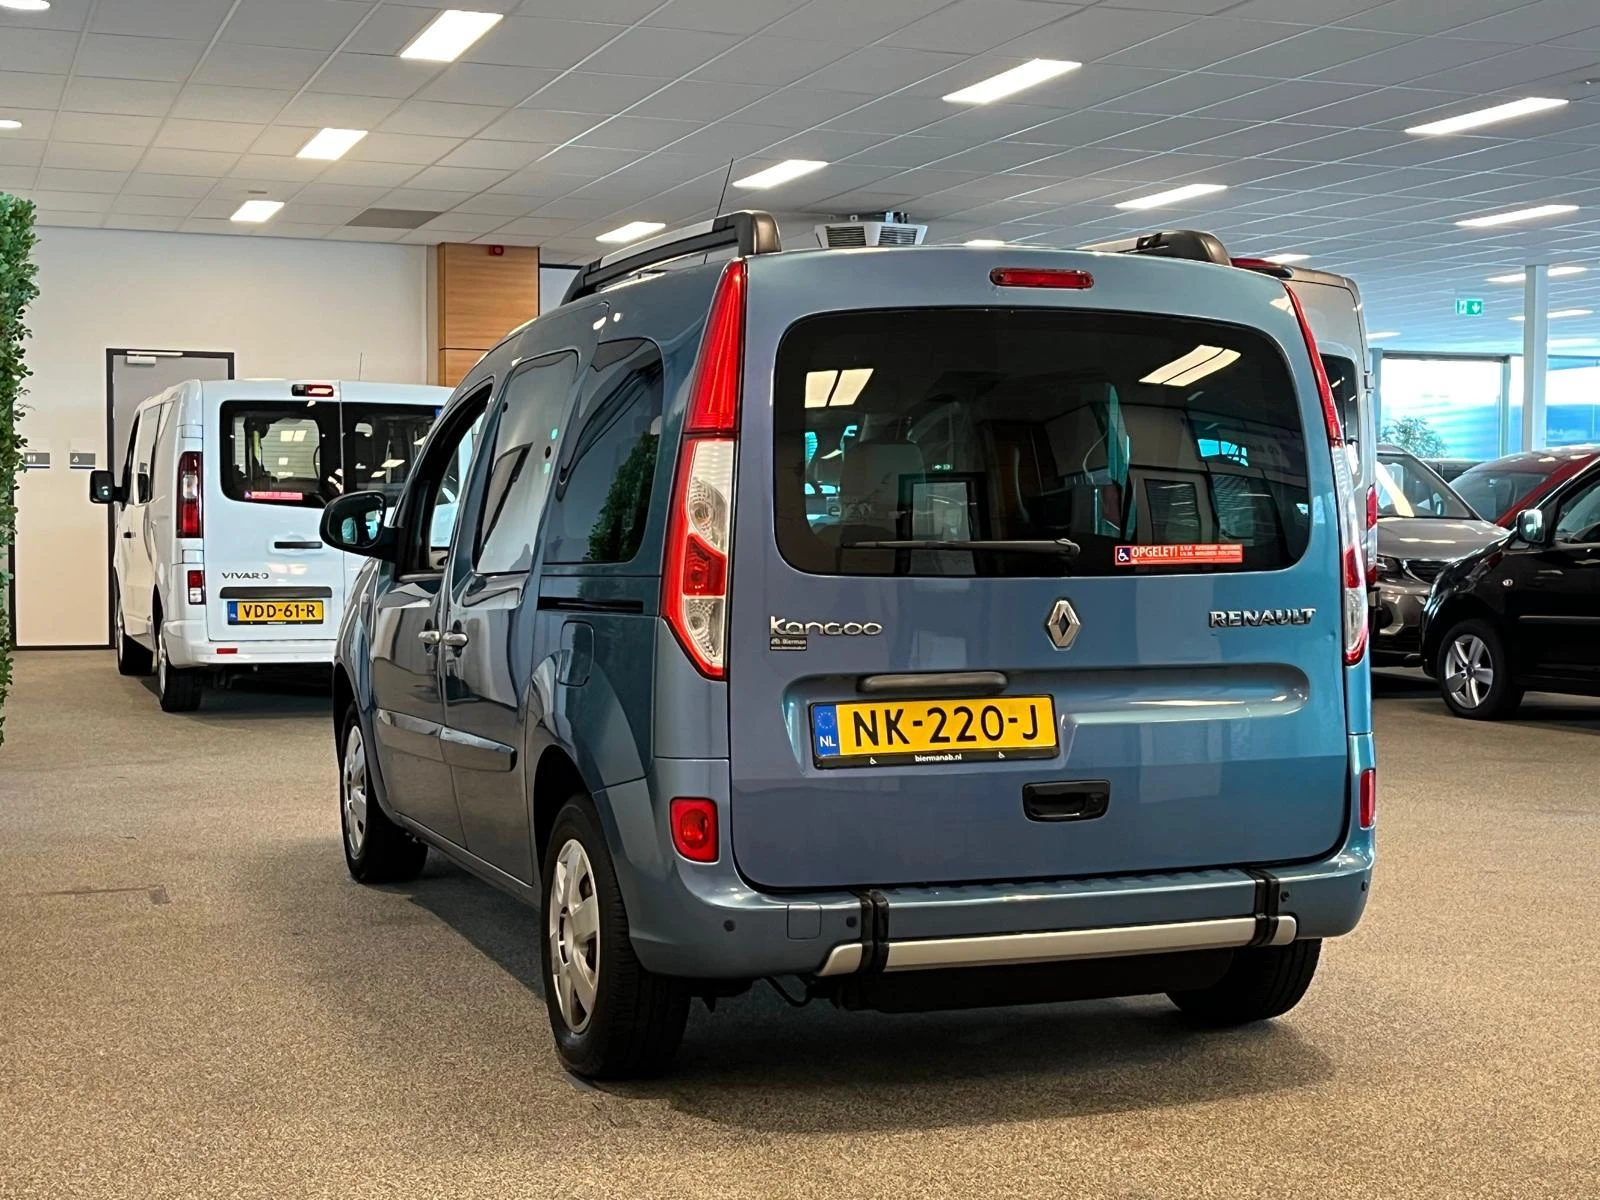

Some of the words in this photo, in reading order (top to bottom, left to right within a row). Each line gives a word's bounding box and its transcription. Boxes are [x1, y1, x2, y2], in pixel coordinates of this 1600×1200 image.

[221, 572, 269, 580] VIVARO
[243, 604, 316, 618] VDD-61-R
[1209, 607, 1317, 628] RENAULT
[853, 704, 1039, 748] NK-220-J
[820, 735, 837, 748] NL
[914, 753, 963, 763] biermanab.nl
